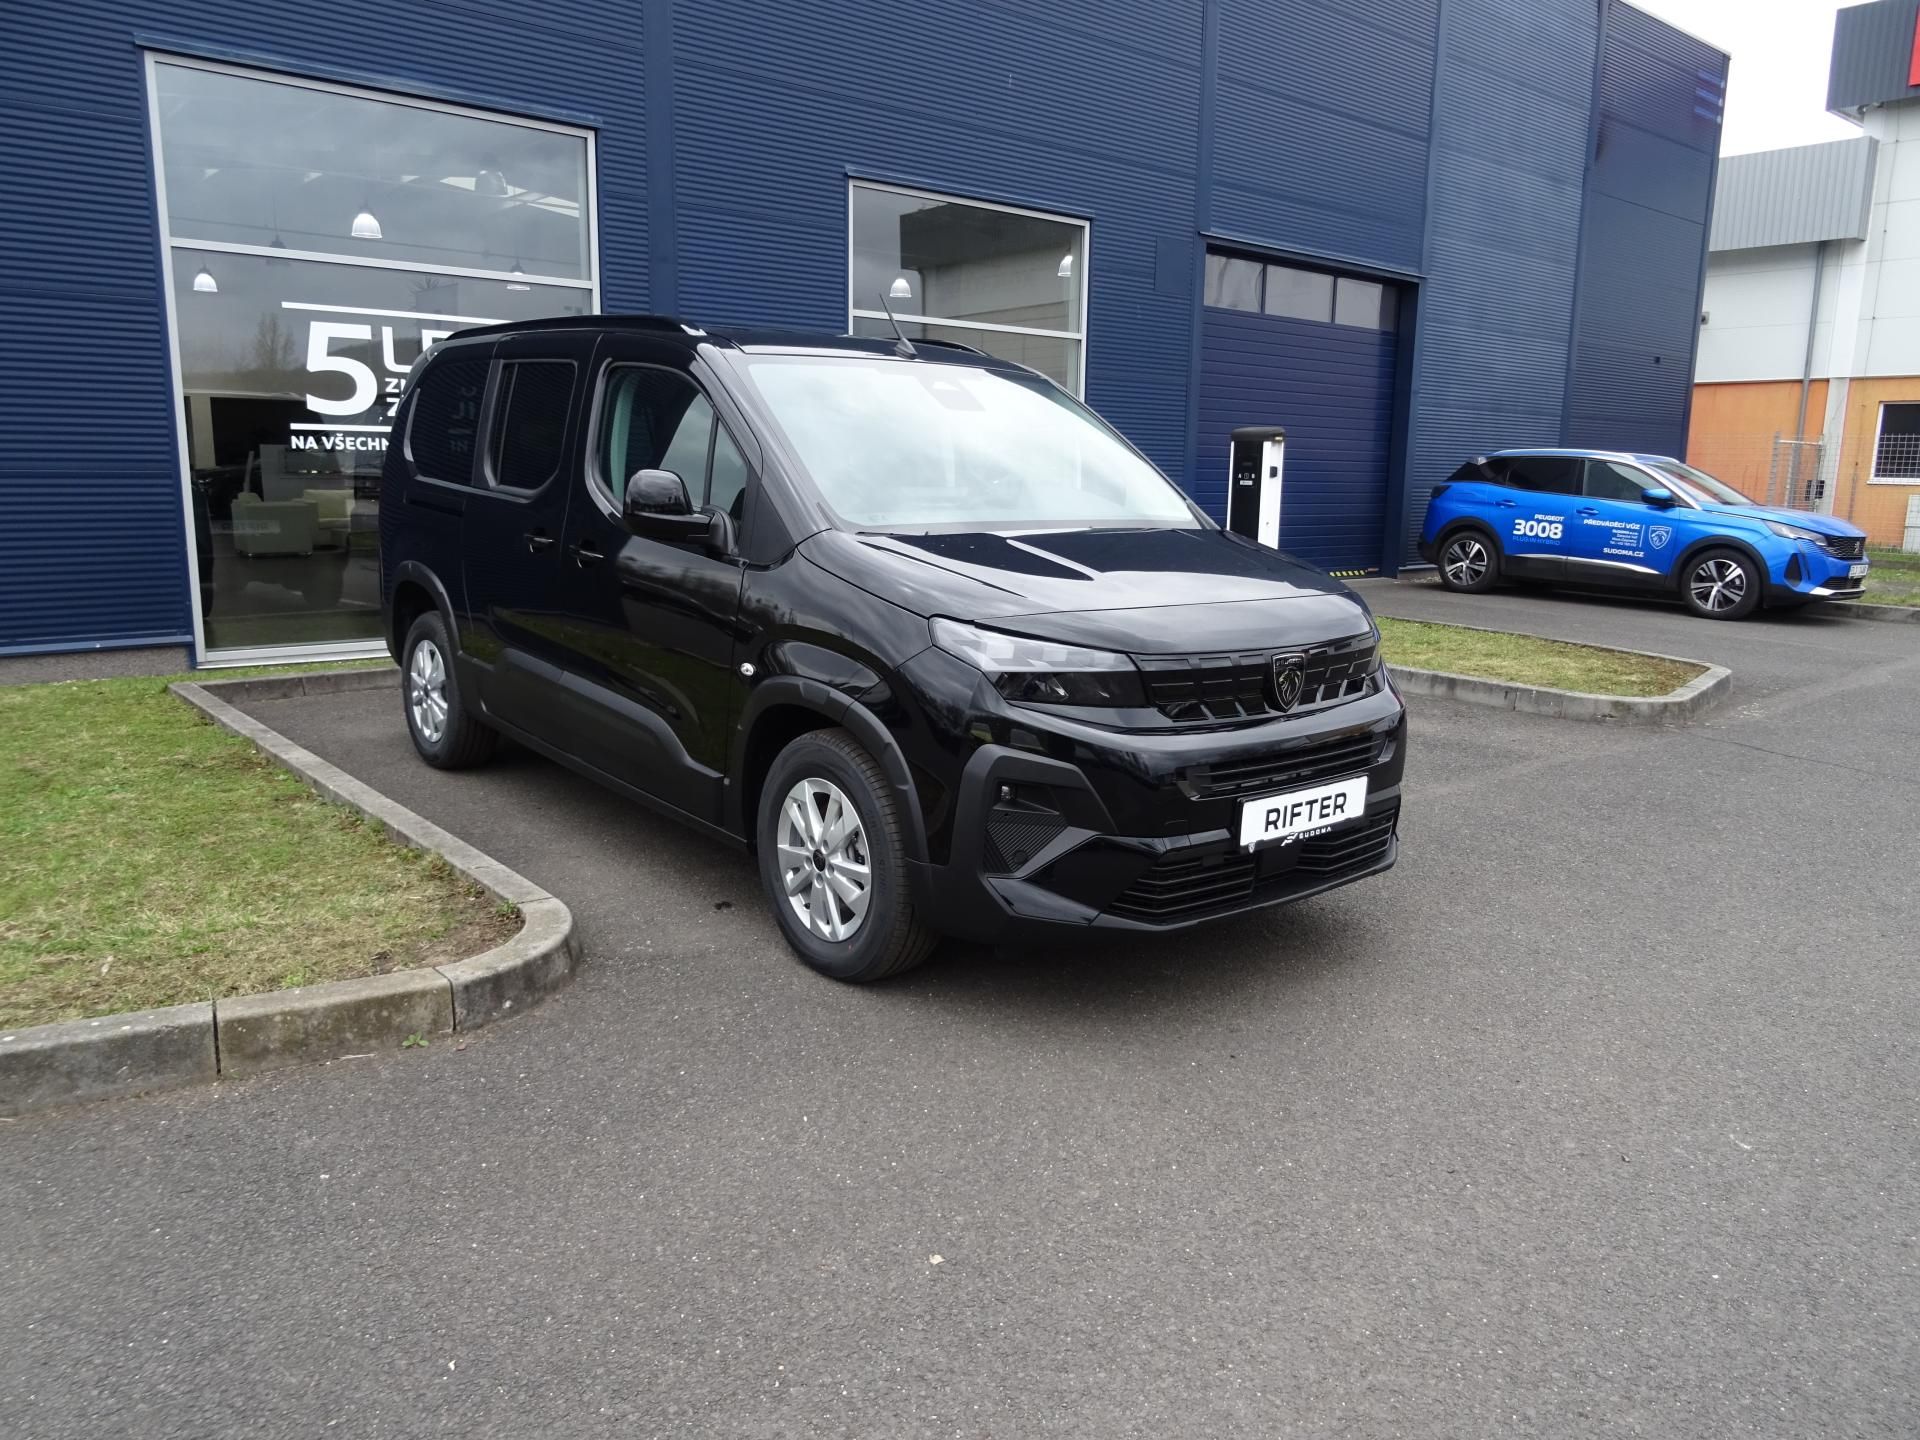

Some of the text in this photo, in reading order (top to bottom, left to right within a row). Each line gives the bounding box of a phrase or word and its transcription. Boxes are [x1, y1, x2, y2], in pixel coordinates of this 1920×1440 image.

[305, 320, 378, 416] 5
[290, 435, 318, 450] NA
[1534, 513, 1565, 522] PEUGEOT
[1512, 519, 1563, 539] 3008
[1603, 547, 1645, 558] SUDOMA.CZ
[1264, 791, 1347, 833] RIFTER
